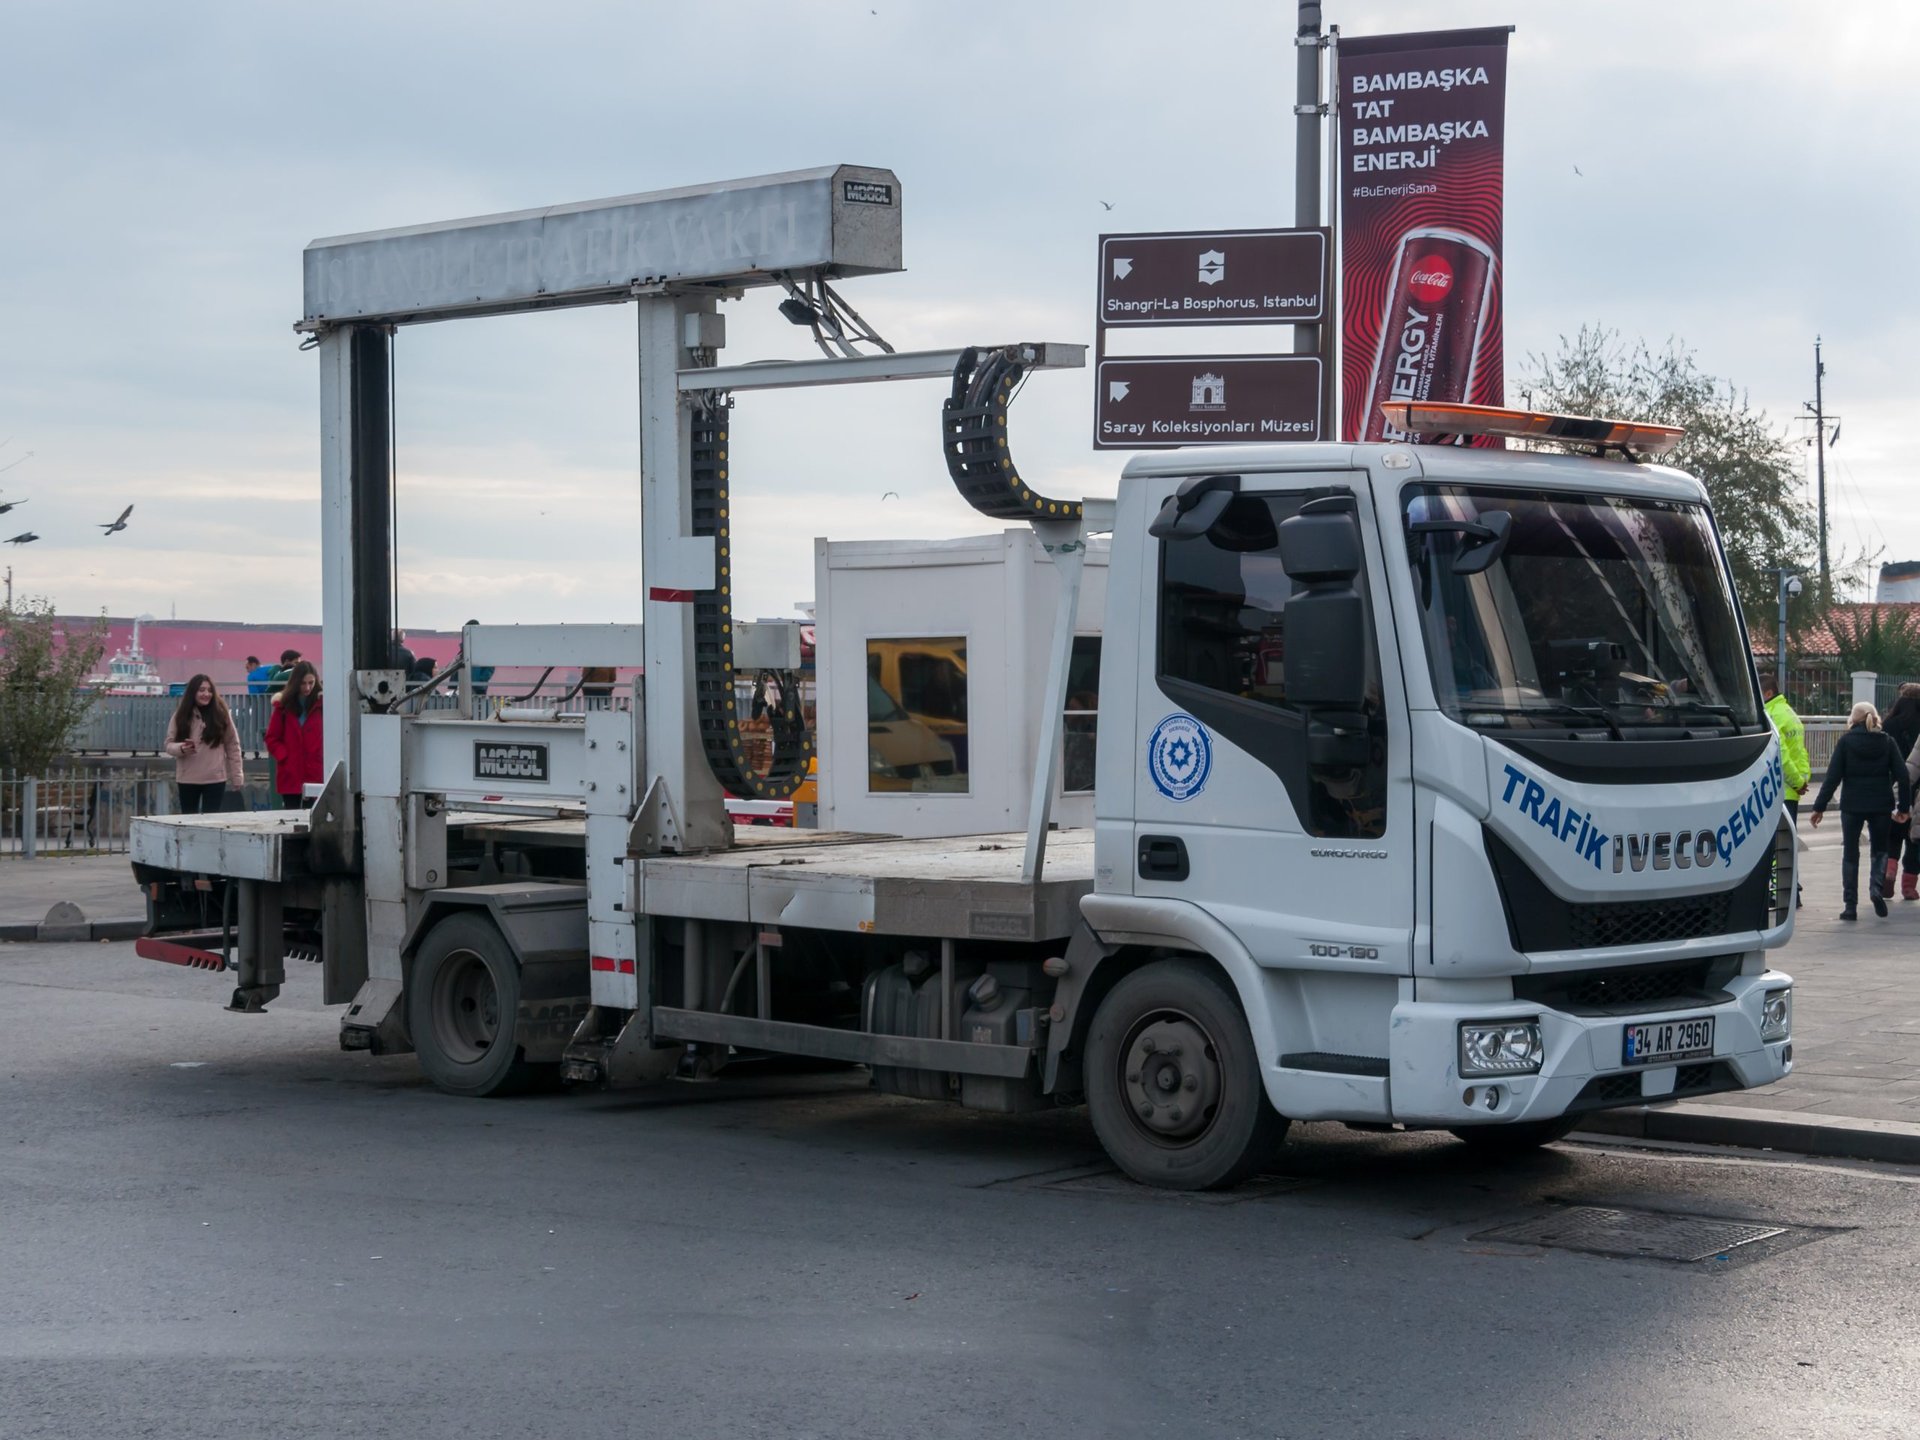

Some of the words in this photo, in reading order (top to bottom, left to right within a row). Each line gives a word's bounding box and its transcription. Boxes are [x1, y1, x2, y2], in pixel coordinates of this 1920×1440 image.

[1353, 66, 1490, 92] BAMBAŞKA
[1352, 99, 1395, 119] TAT
[1353, 120, 1489, 145] BAMBAŞKA
[1352, 183, 1437, 198] #BuEnerjiSana
[1107, 297, 1180, 313] Shangri-La
[1183, 296, 1259, 312] Bosphorus,
[1263, 294, 1317, 308] Istanbul
[1382, 306, 1429, 441] EERGY
[1103, 420, 1146, 436] Saray
[1152, 419, 1255, 436] Koleksiyonları
[1260, 419, 1315, 432] Müzesi
[1502, 763, 1610, 871] TRAFİK
[1716, 746, 1783, 868] ÇEKİCİS
[1612, 829, 1718, 874] IVECO
[1635, 1028, 1651, 1055] 34
[1656, 1025, 1673, 1052] AR
[1677, 1021, 1710, 1049] 2960
